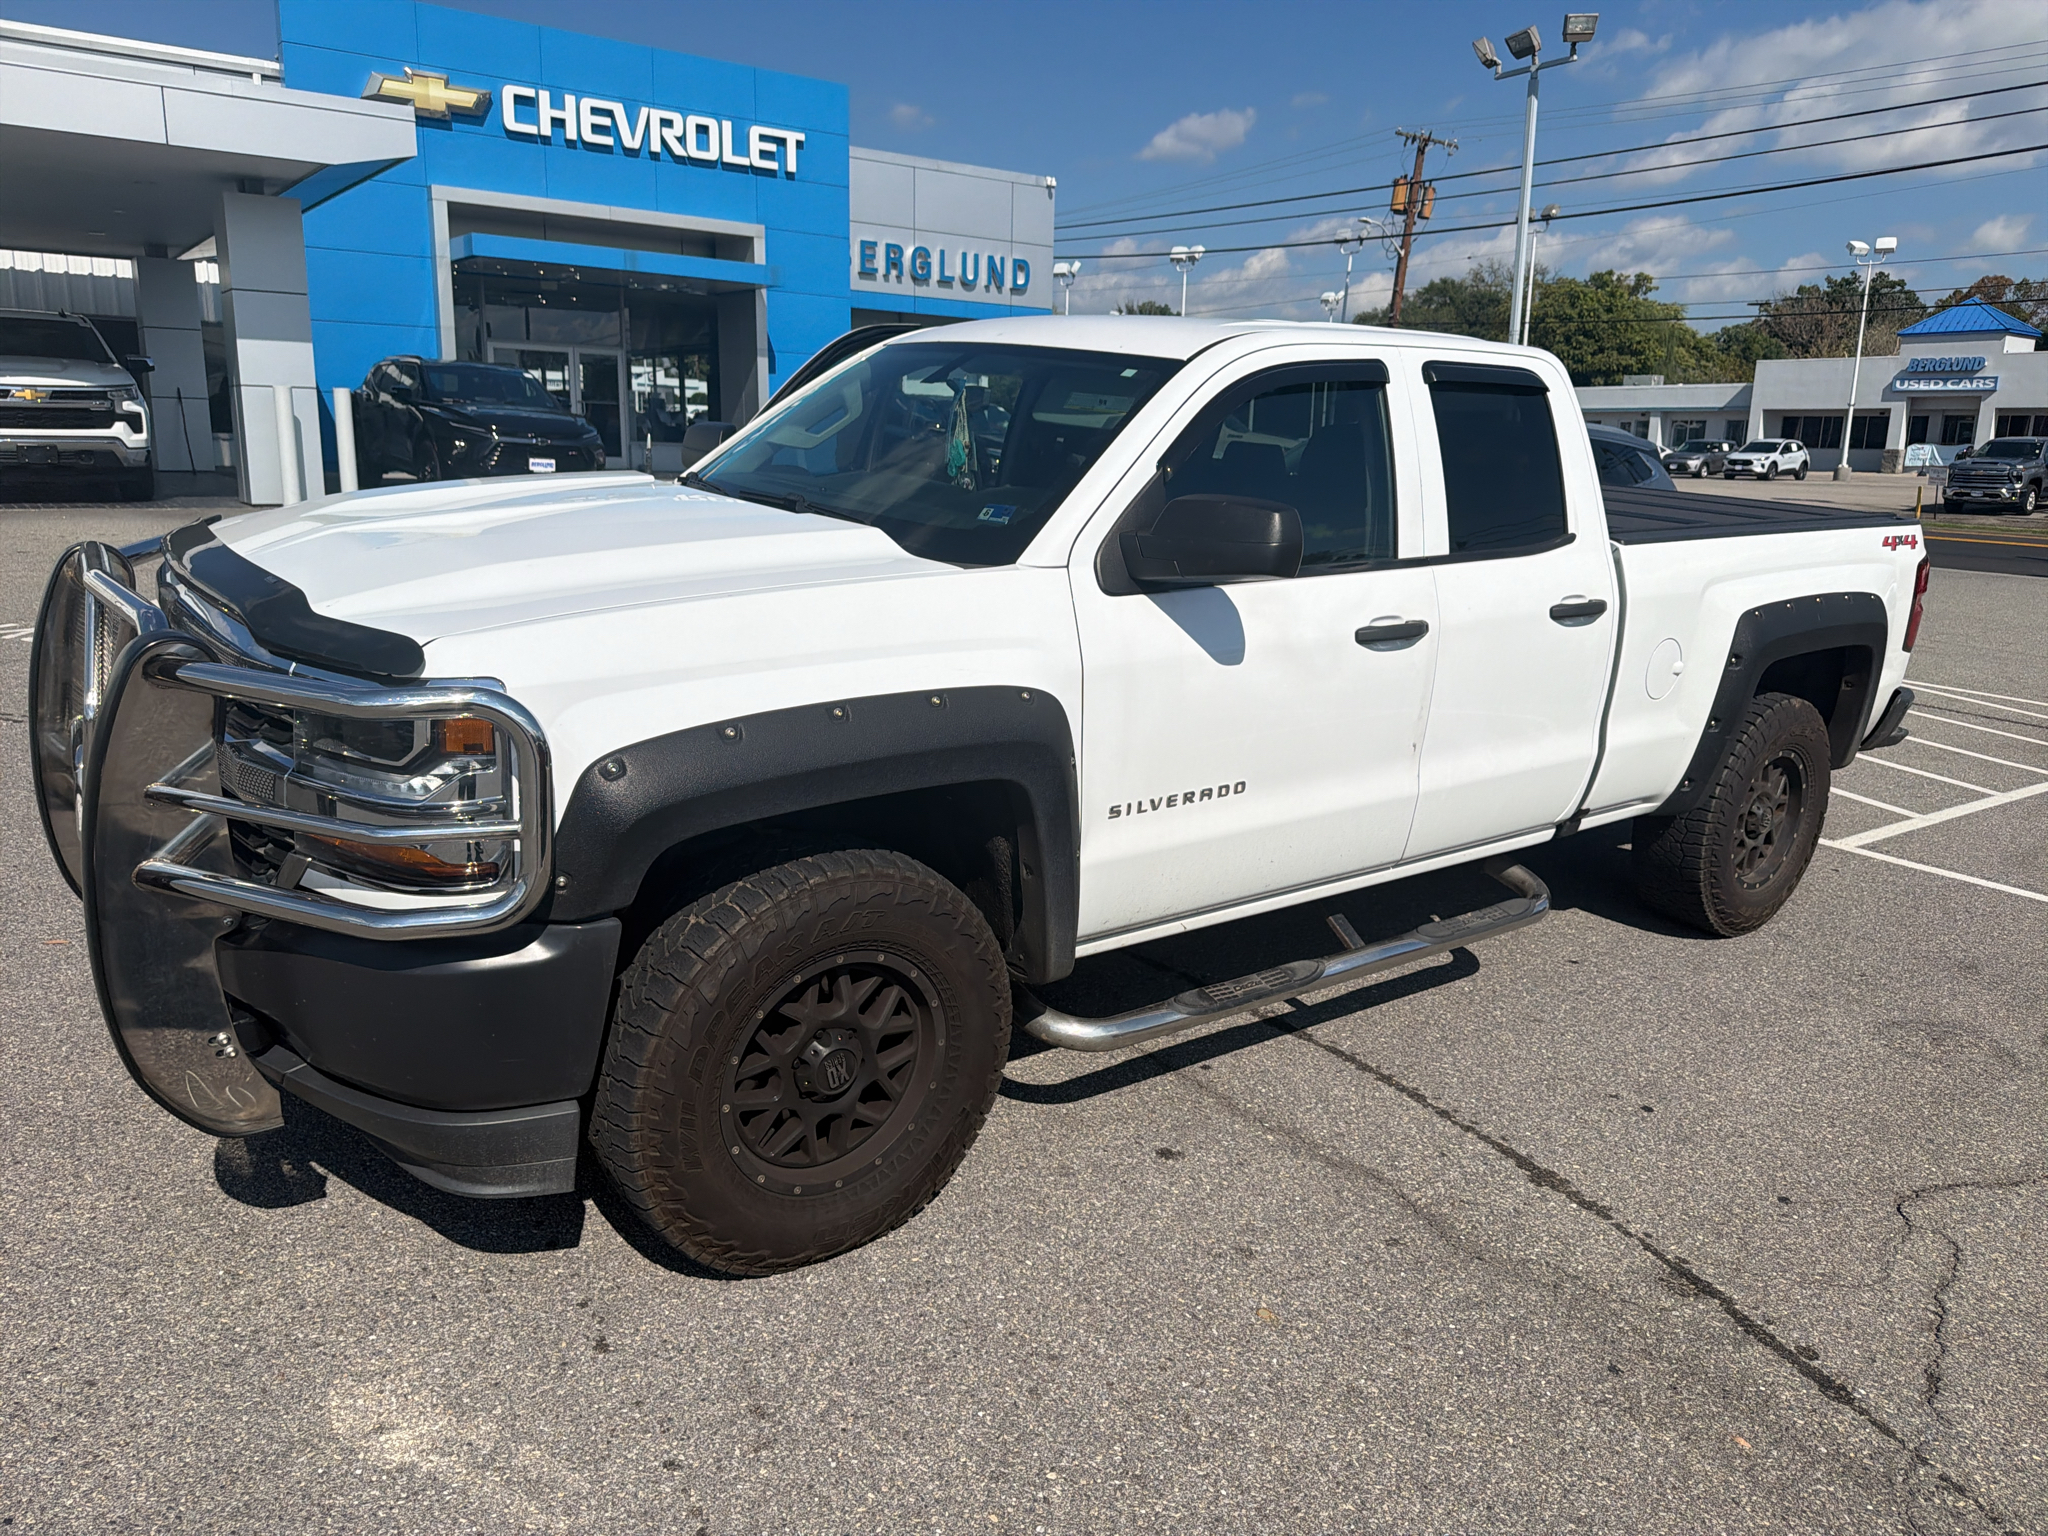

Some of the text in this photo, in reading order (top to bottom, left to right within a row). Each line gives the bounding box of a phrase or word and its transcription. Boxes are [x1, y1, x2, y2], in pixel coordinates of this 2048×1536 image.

[502, 84, 805, 173] CHEVROLET
[850, 240, 1030, 289] ERGLUND
[1895, 379, 1996, 389] USED CARS
[1907, 357, 1986, 373] BERGLUND
[1108, 780, 1247, 820] SILVERADO
